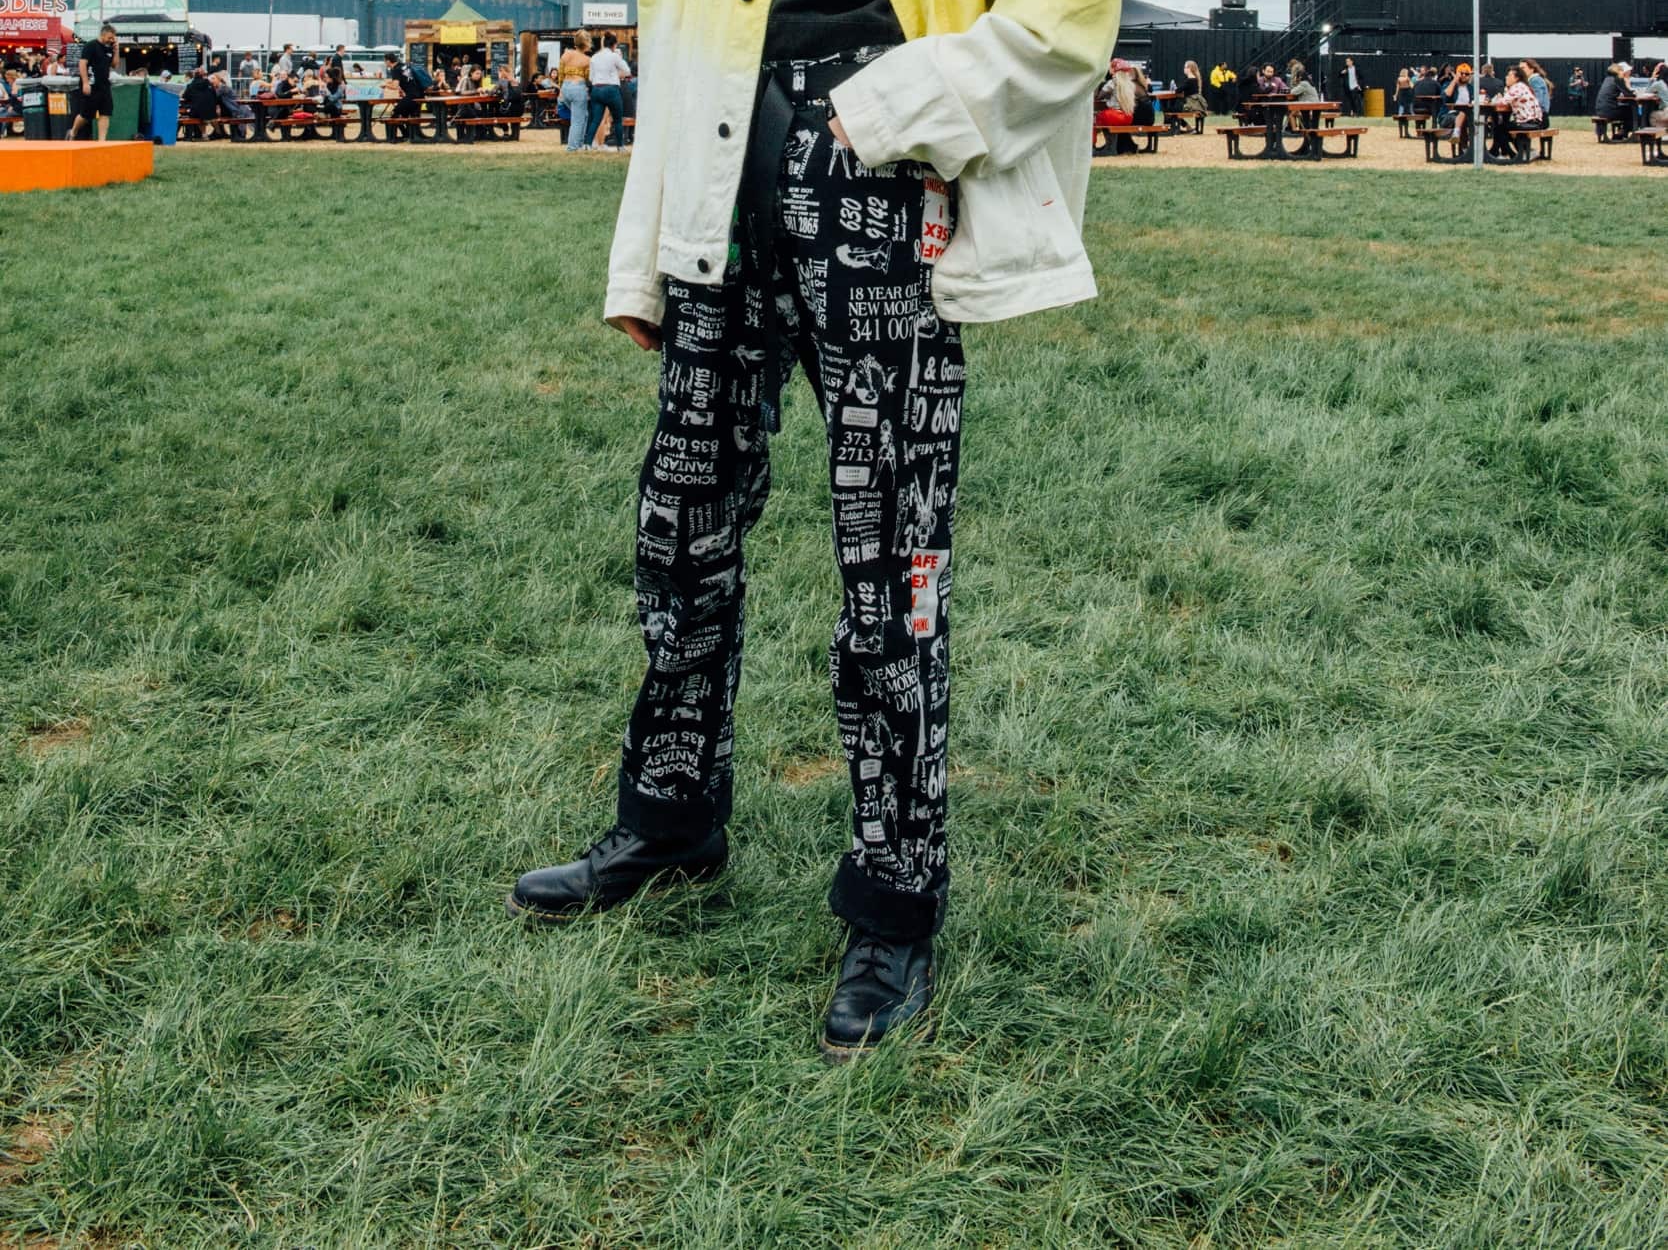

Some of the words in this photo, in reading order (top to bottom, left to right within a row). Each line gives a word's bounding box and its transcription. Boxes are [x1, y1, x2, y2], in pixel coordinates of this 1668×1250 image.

[839, 197, 863, 231] 630
[865, 196, 888, 239] 9142
[923, 222, 949, 242] SEX
[920, 242, 945, 259] AF
[813, 258, 829, 279] TIE
[850, 287, 864, 300] 18
[867, 286, 902, 300] YEAR
[848, 302, 880, 316] NEW
[850, 318, 880, 342] 341
[924, 356, 937, 381] &
[691, 389, 708, 409] 630
[656, 430, 687, 450] 0477
[691, 439, 720, 453] 835
[842, 431, 872, 447] 373
[656, 454, 714, 473] FANTASY
[836, 447, 875, 463] 2713
[858, 581, 879, 626] 9142
[642, 731, 677, 748] 0477
[681, 731, 706, 748] 835
[645, 749, 700, 768] FANTASY
